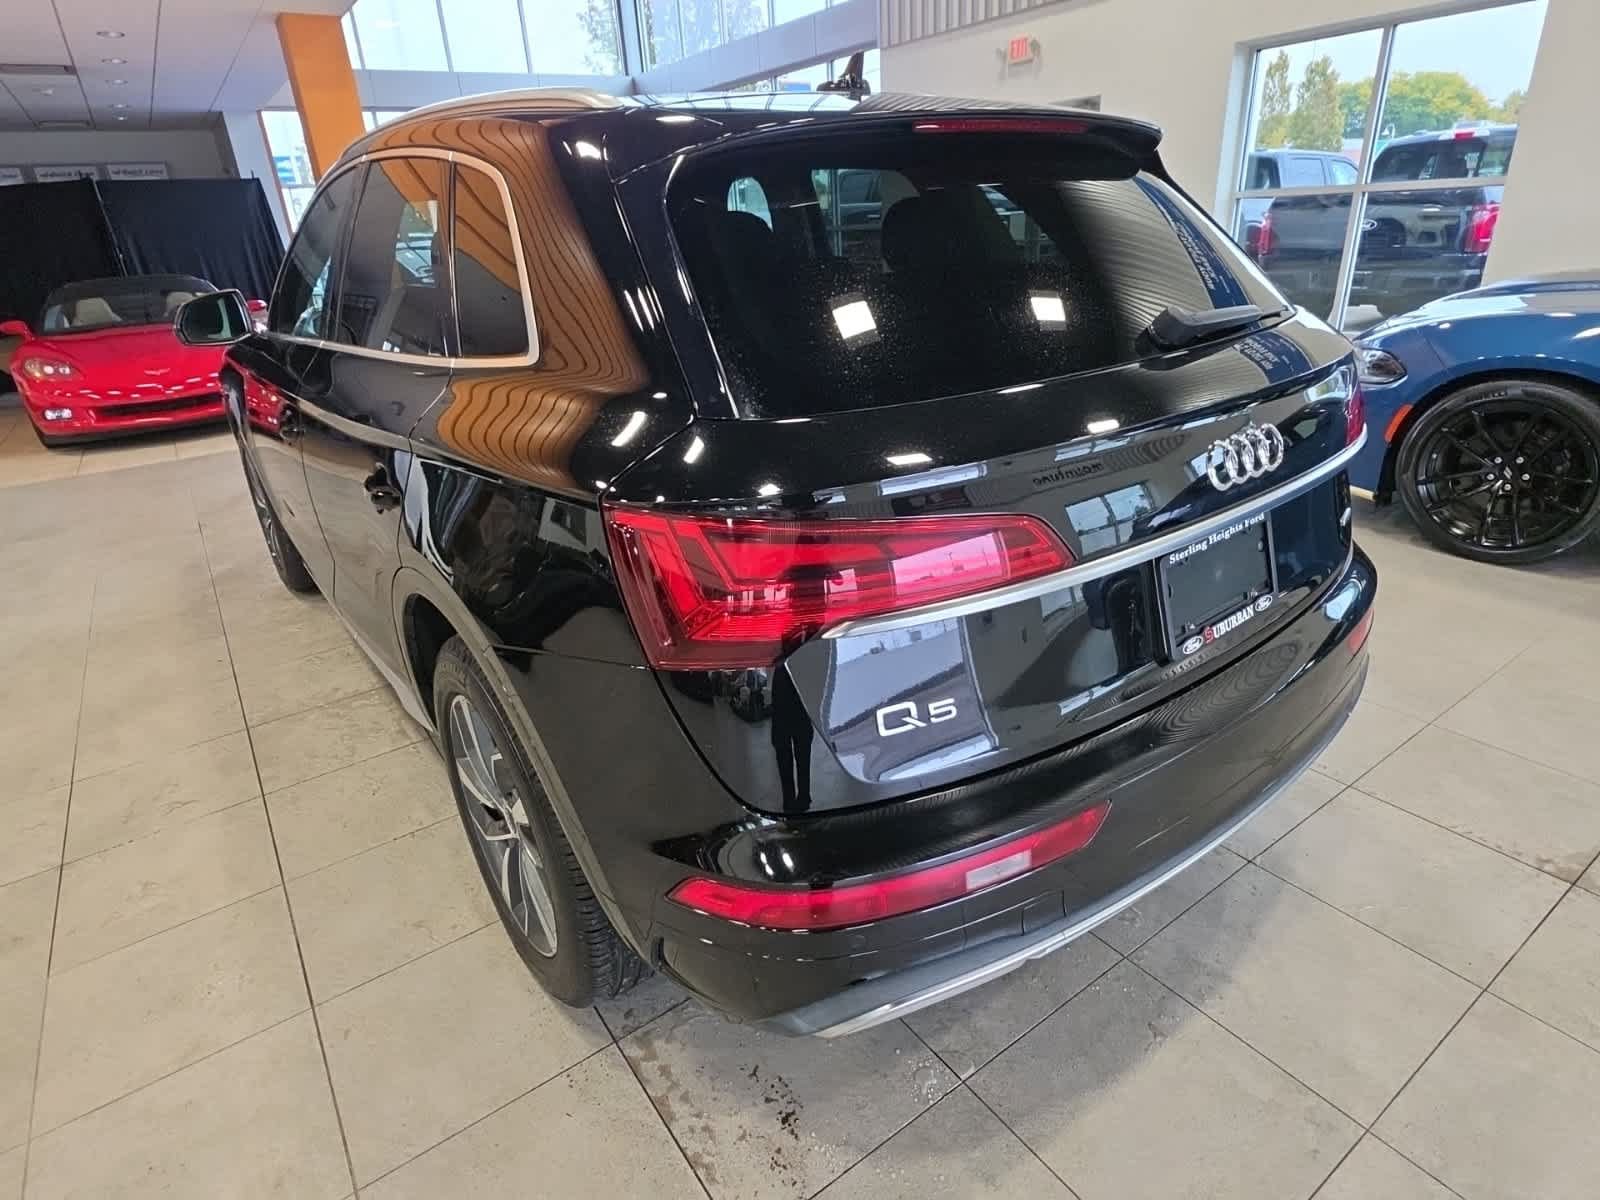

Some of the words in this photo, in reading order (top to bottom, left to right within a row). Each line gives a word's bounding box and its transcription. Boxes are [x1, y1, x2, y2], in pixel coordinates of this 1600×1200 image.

[1010, 39, 1028, 59] EXIT
[1169, 539, 1208, 564] Sterling
[1208, 523, 1243, 545] Heights
[1244, 511, 1265, 527] Ford
[1204, 605, 1255, 643] SUBURBAN
[876, 698, 957, 737] Q5
